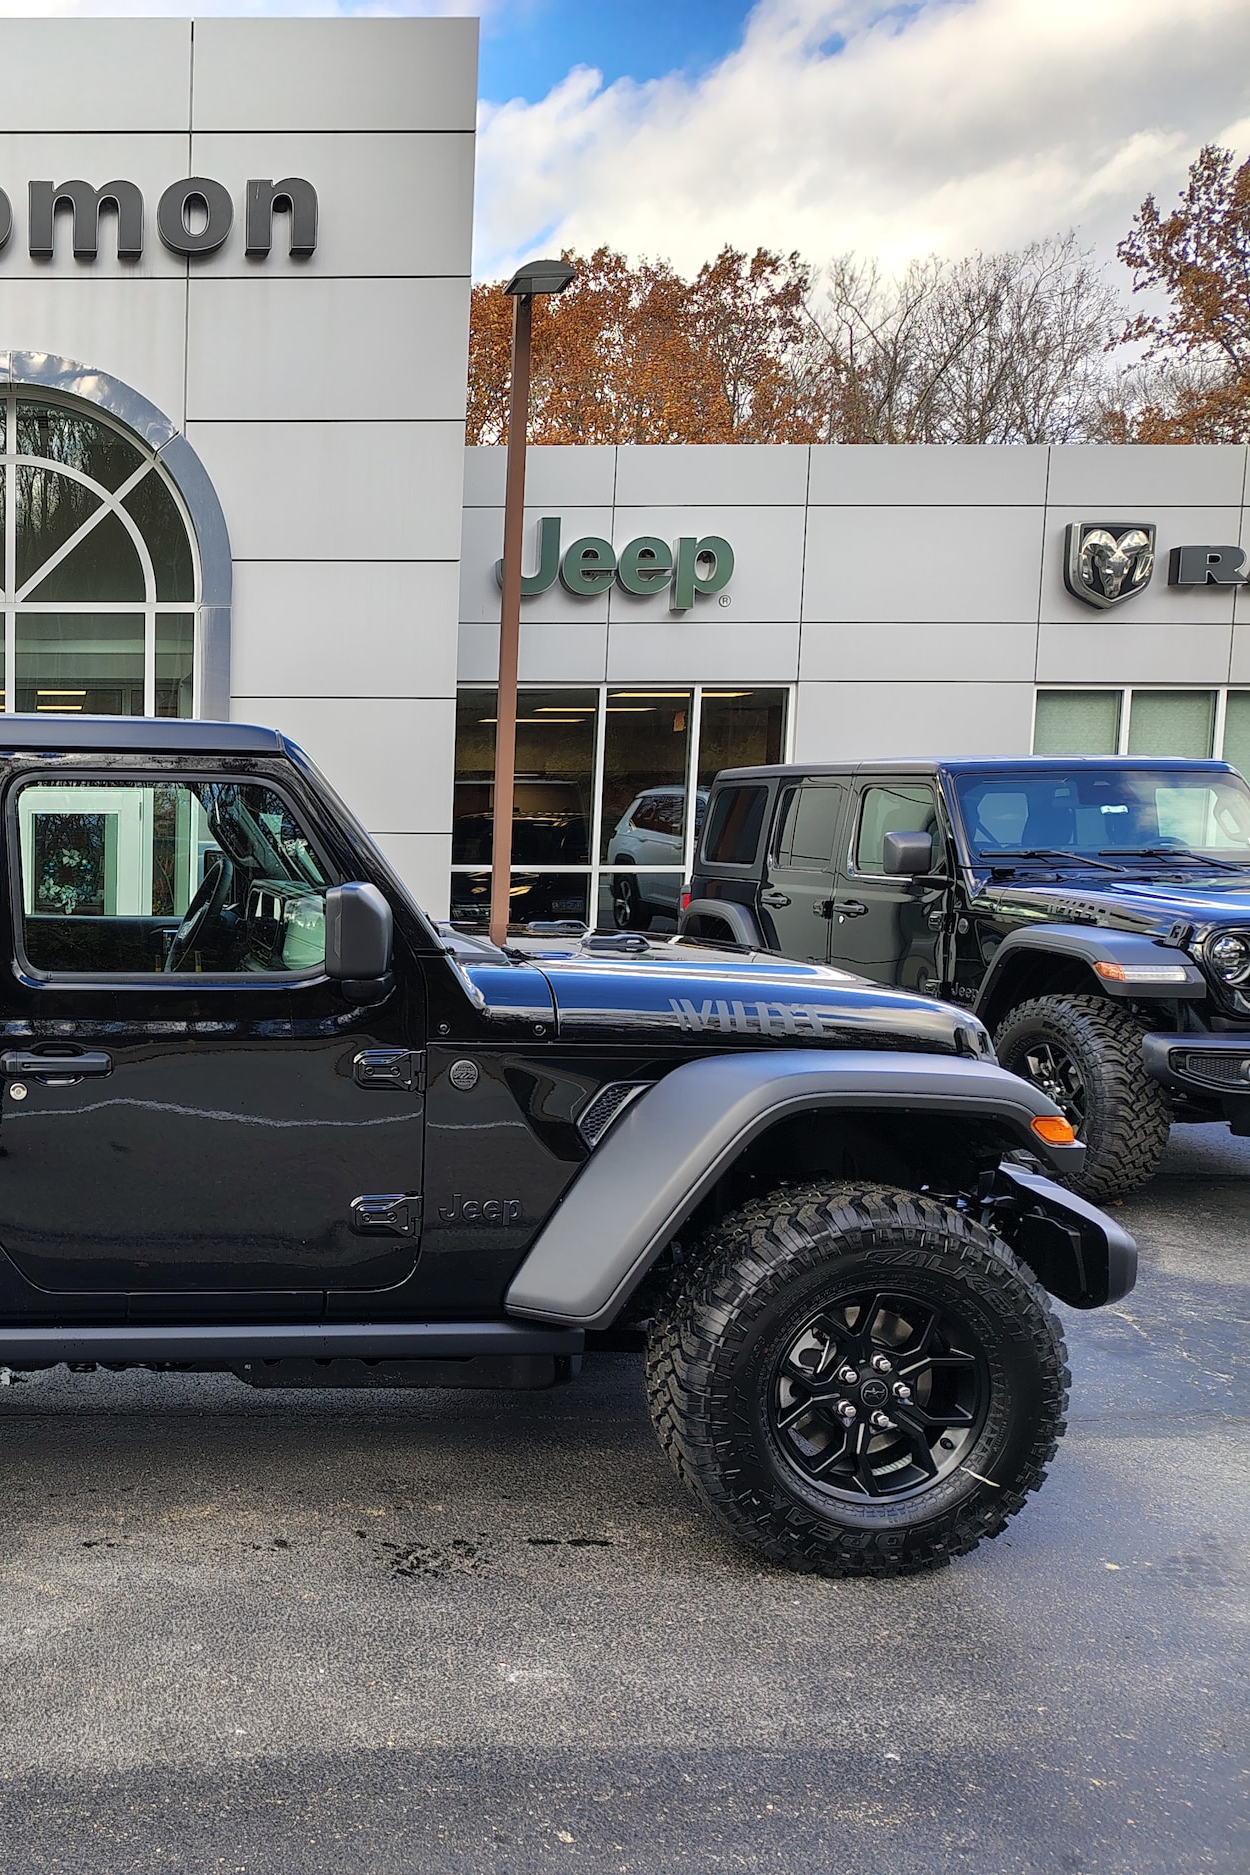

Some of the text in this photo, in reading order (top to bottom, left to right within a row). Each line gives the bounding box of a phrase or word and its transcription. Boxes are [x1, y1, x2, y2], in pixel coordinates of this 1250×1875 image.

[495, 516, 735, 611] Jeep
[1168, 545, 1250, 586] R
[438, 1193, 523, 1226] Jeep
